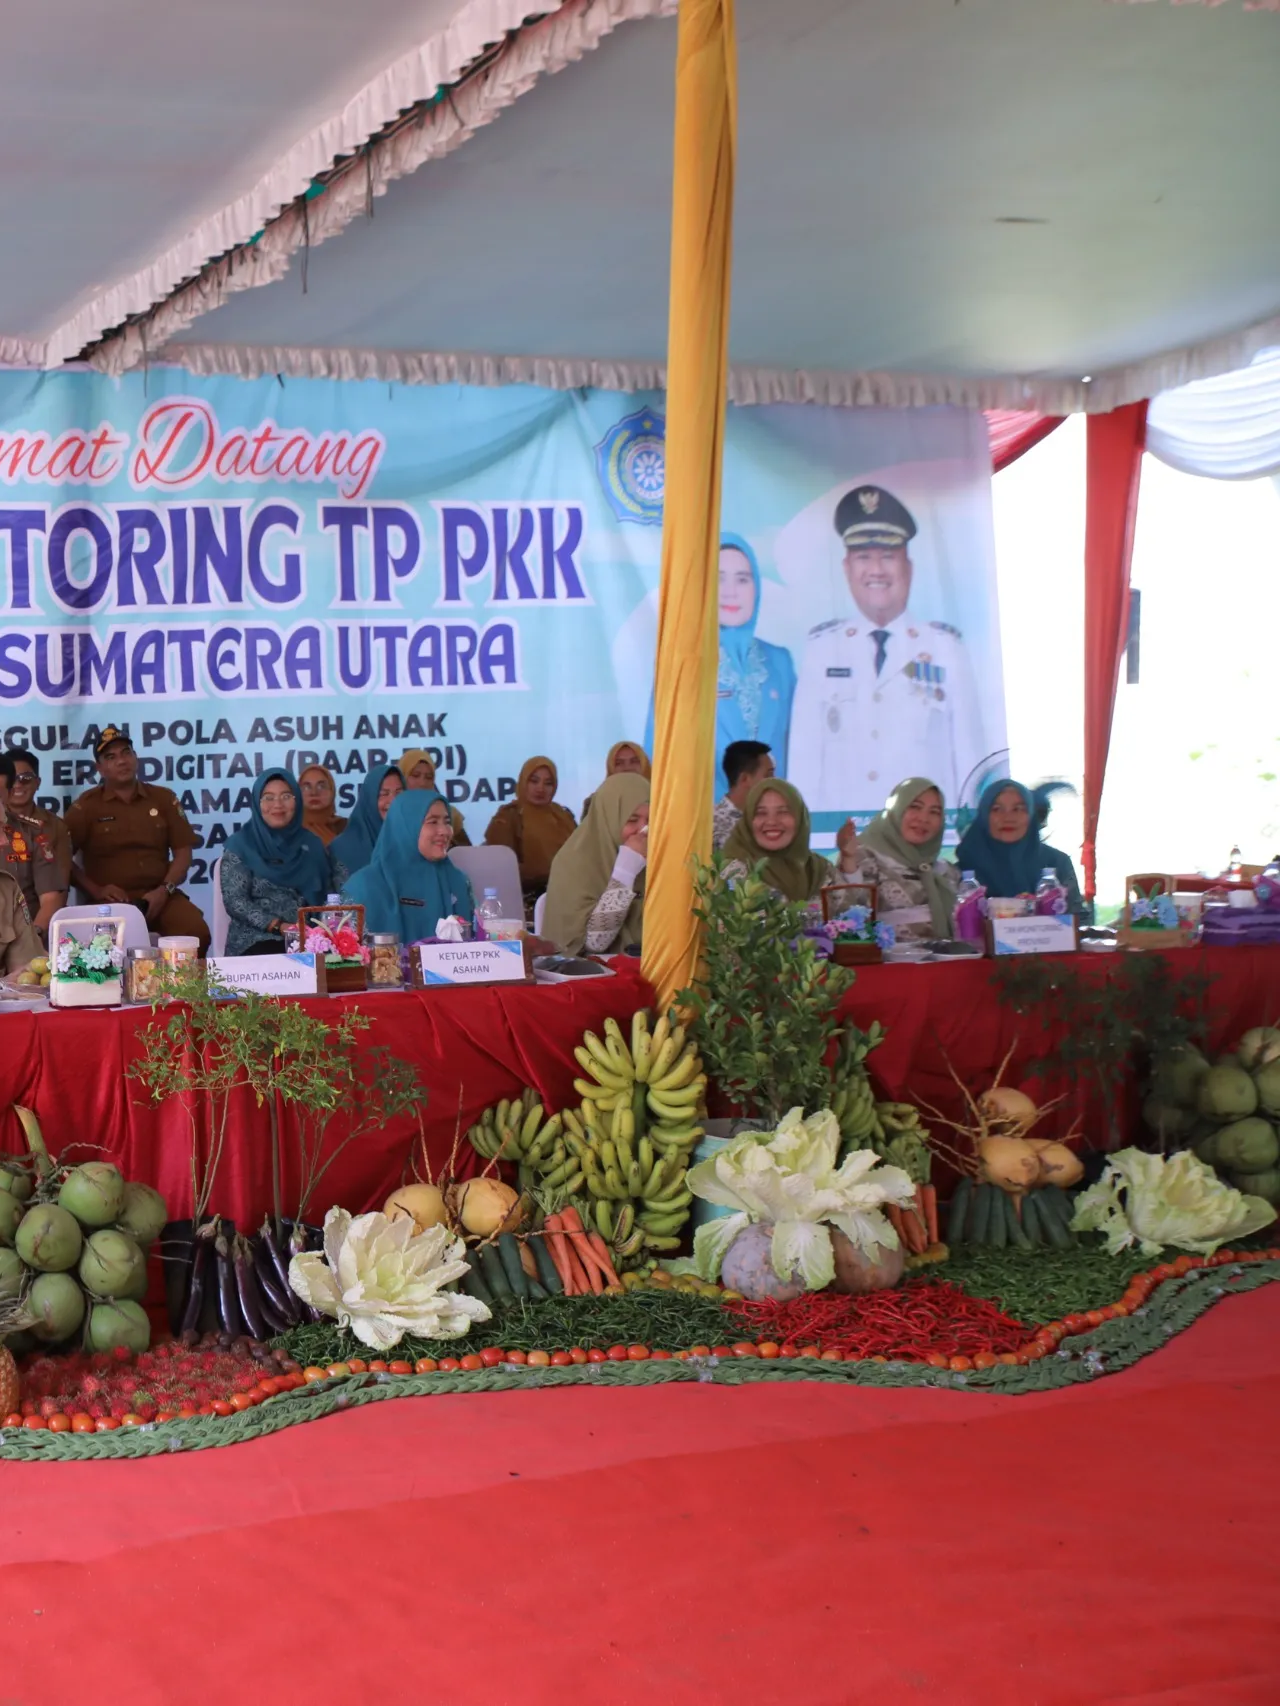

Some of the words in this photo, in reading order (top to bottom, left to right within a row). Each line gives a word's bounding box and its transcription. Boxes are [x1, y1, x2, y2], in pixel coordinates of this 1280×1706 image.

[134, 403, 381, 499] Datang
[322, 505, 420, 601] TP
[441, 506, 587, 601] PKK
[337, 623, 517, 690] UTARA
[141, 716, 238, 748] POLA
[247, 714, 344, 744] ASUH
[354, 712, 449, 739] ANAK
[53, 758, 107, 787] ER
[136, 751, 264, 782] DIGITAL
[439, 951, 469, 961] KETUA
[470, 951, 481, 960] TP
[483, 950, 500, 959] PKK
[453, 964, 490, 974] ASAHAN
[226, 973, 260, 983] BUPATI
[261, 970, 301, 981] ASAHAN
